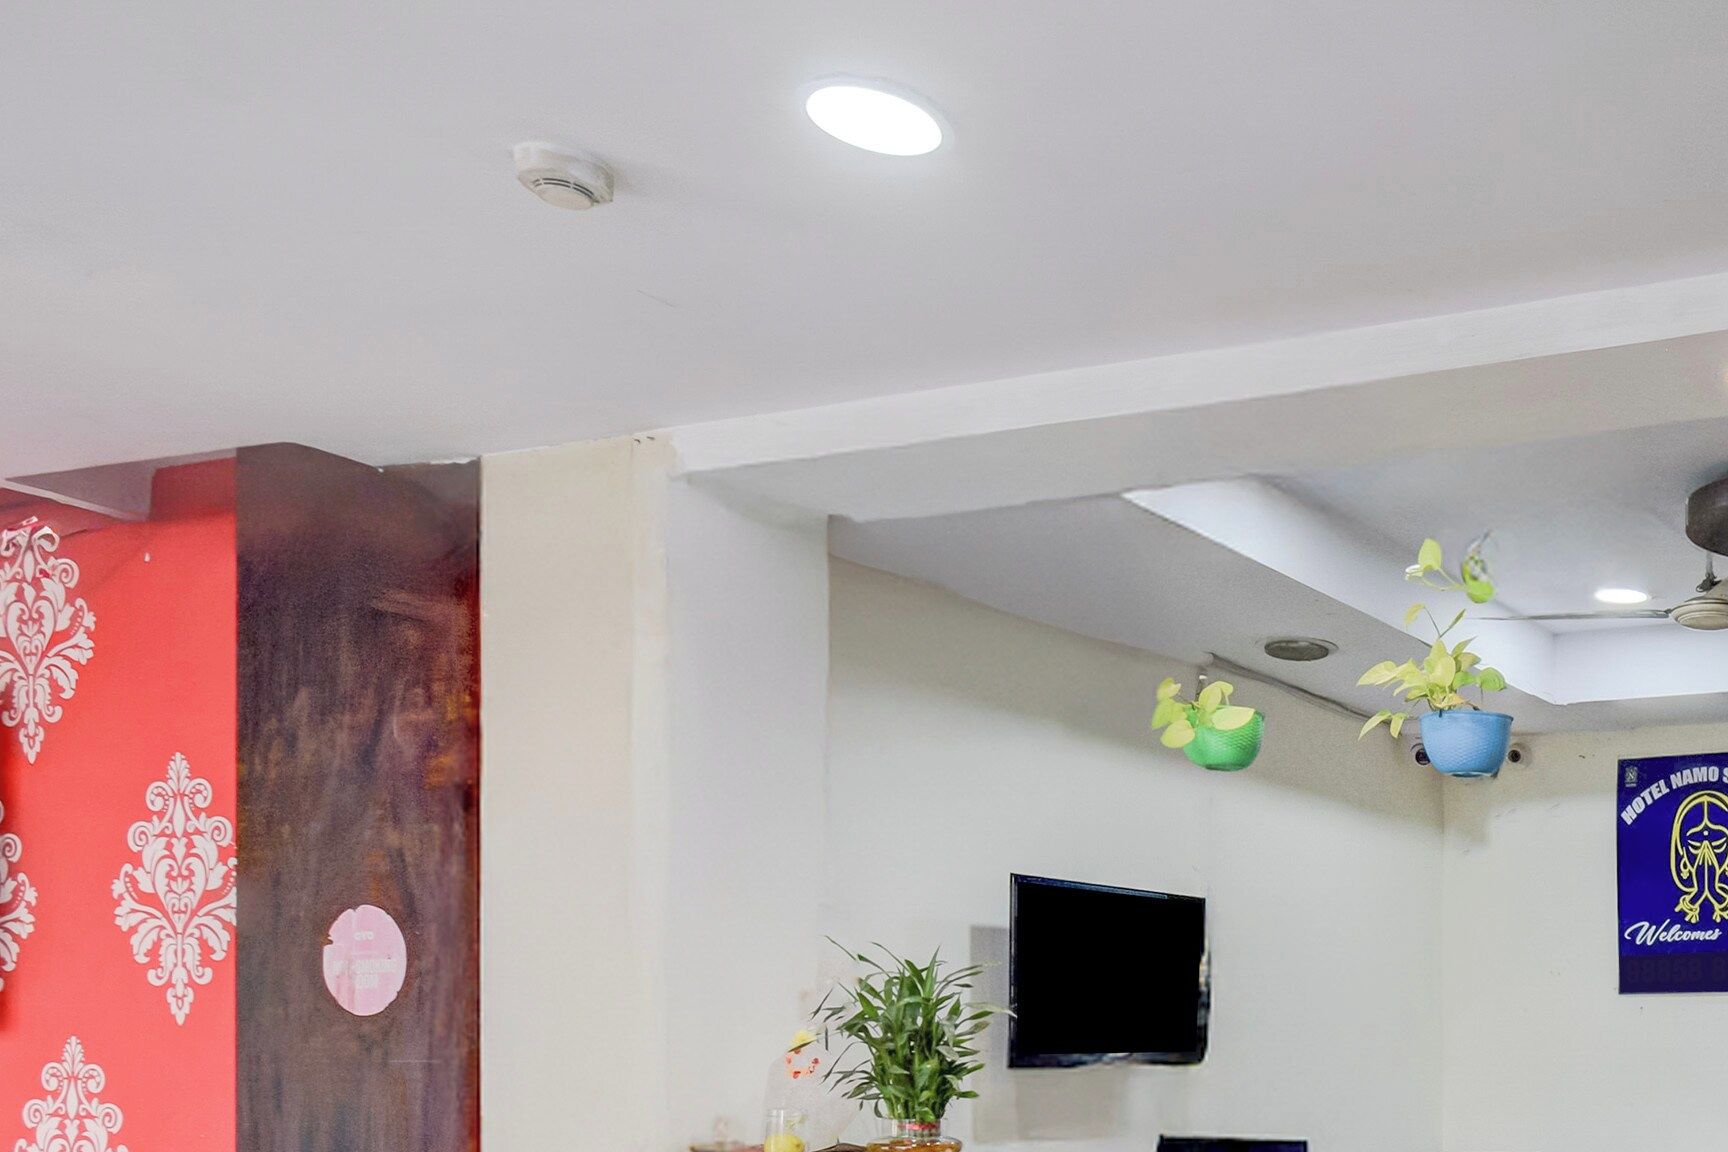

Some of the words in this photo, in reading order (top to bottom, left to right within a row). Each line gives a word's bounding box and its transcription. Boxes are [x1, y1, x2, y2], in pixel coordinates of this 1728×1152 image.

[1620, 778, 1671, 826] HOTEL
[1669, 765, 1720, 792] NAMO
[1623, 918, 1722, 946] Welcomes
